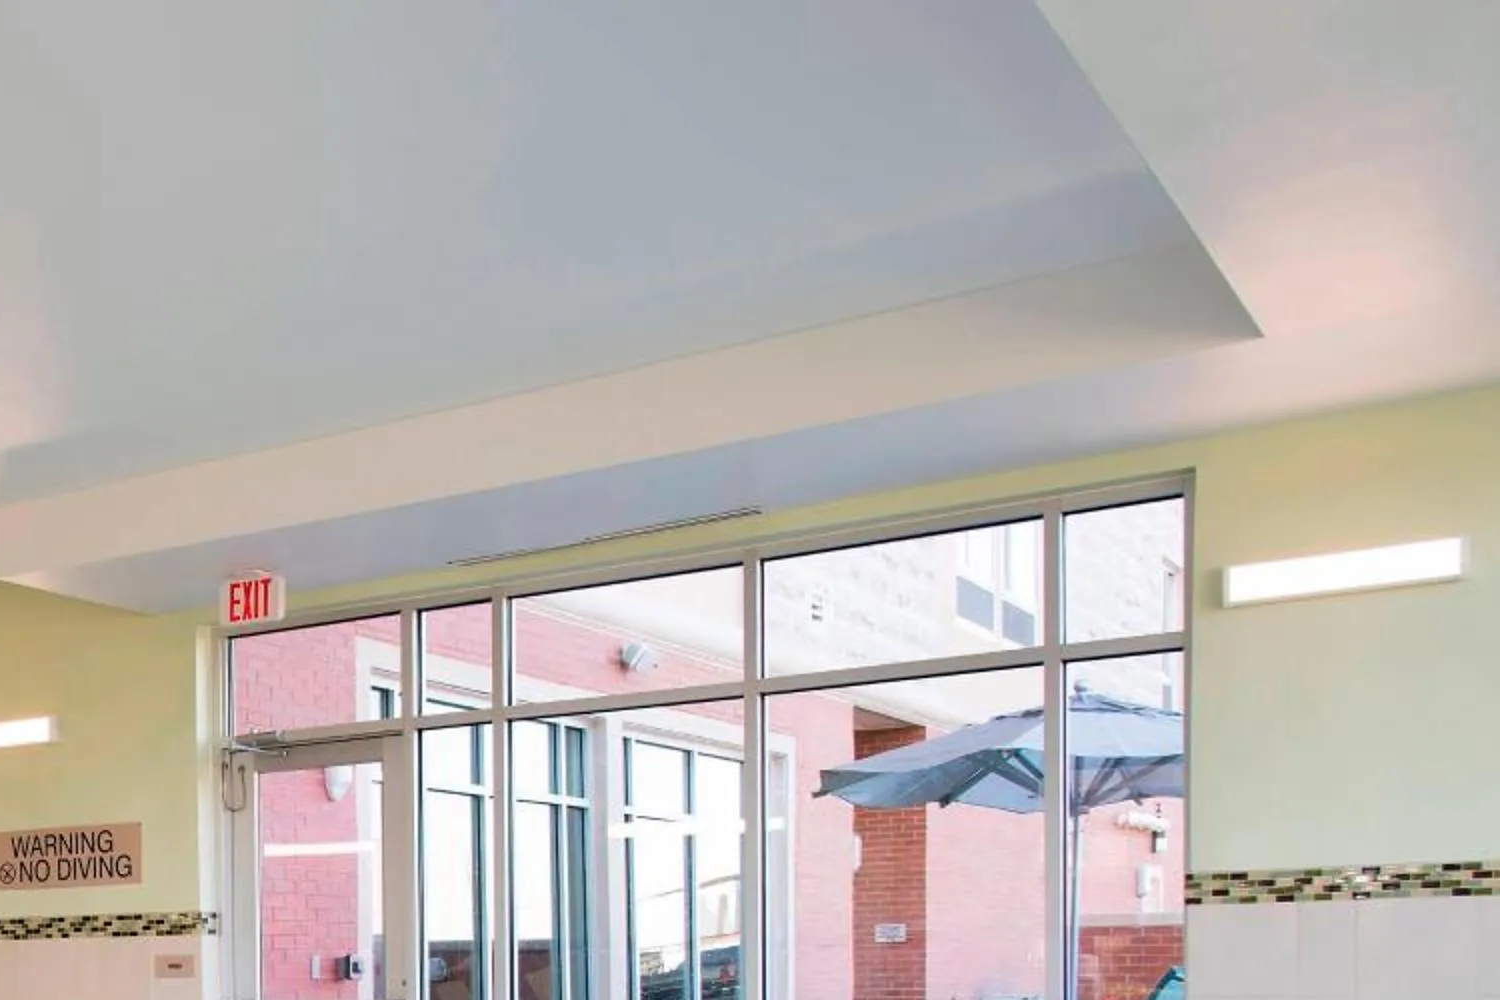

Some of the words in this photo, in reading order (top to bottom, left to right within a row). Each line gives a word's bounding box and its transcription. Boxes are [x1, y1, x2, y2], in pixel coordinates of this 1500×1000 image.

[229, 577, 271, 622] EXIT
[11, 830, 113, 858] WARNING
[19, 859, 51, 882] NO
[57, 854, 132, 880] DIVING
